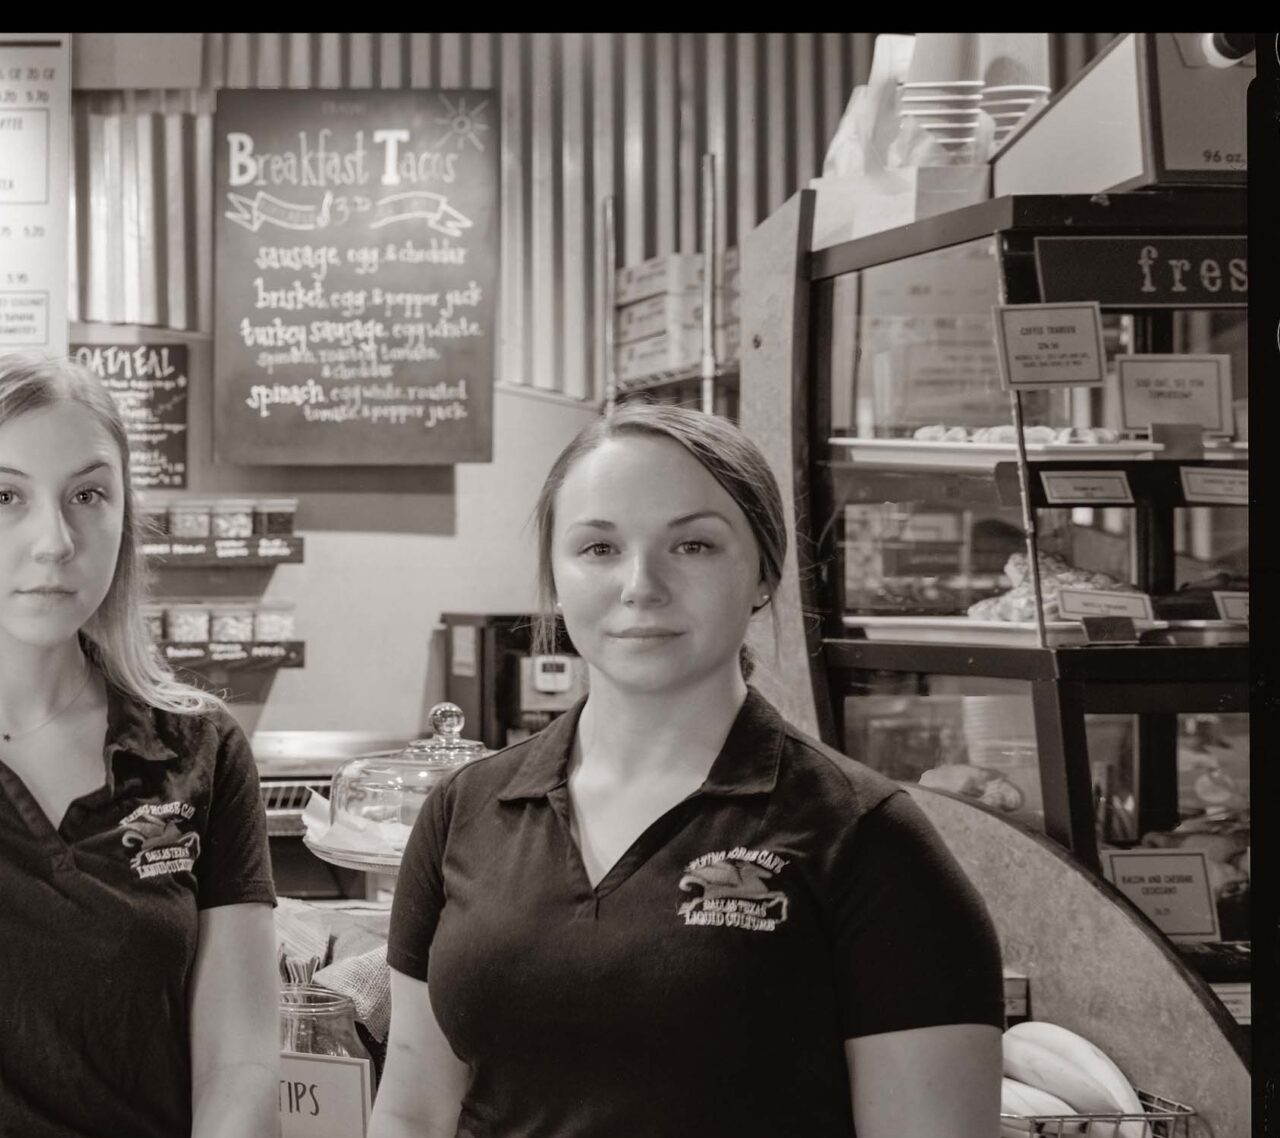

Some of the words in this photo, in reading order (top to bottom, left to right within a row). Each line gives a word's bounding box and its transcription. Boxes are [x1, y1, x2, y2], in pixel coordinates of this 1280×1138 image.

[226, 128, 370, 188] Breakfast
[373, 128, 459, 187] Tacos
[1202, 149, 1223, 163] 96
[240, 317, 308, 352] turkey
[1019, 327, 1044, 336] COFFEE
[75, 345, 176, 379] OATMEAL
[1122, 875, 1146, 885] BACON
[1148, 875, 1162, 884] AND
[1163, 874, 1194, 884] CHEDDAR
